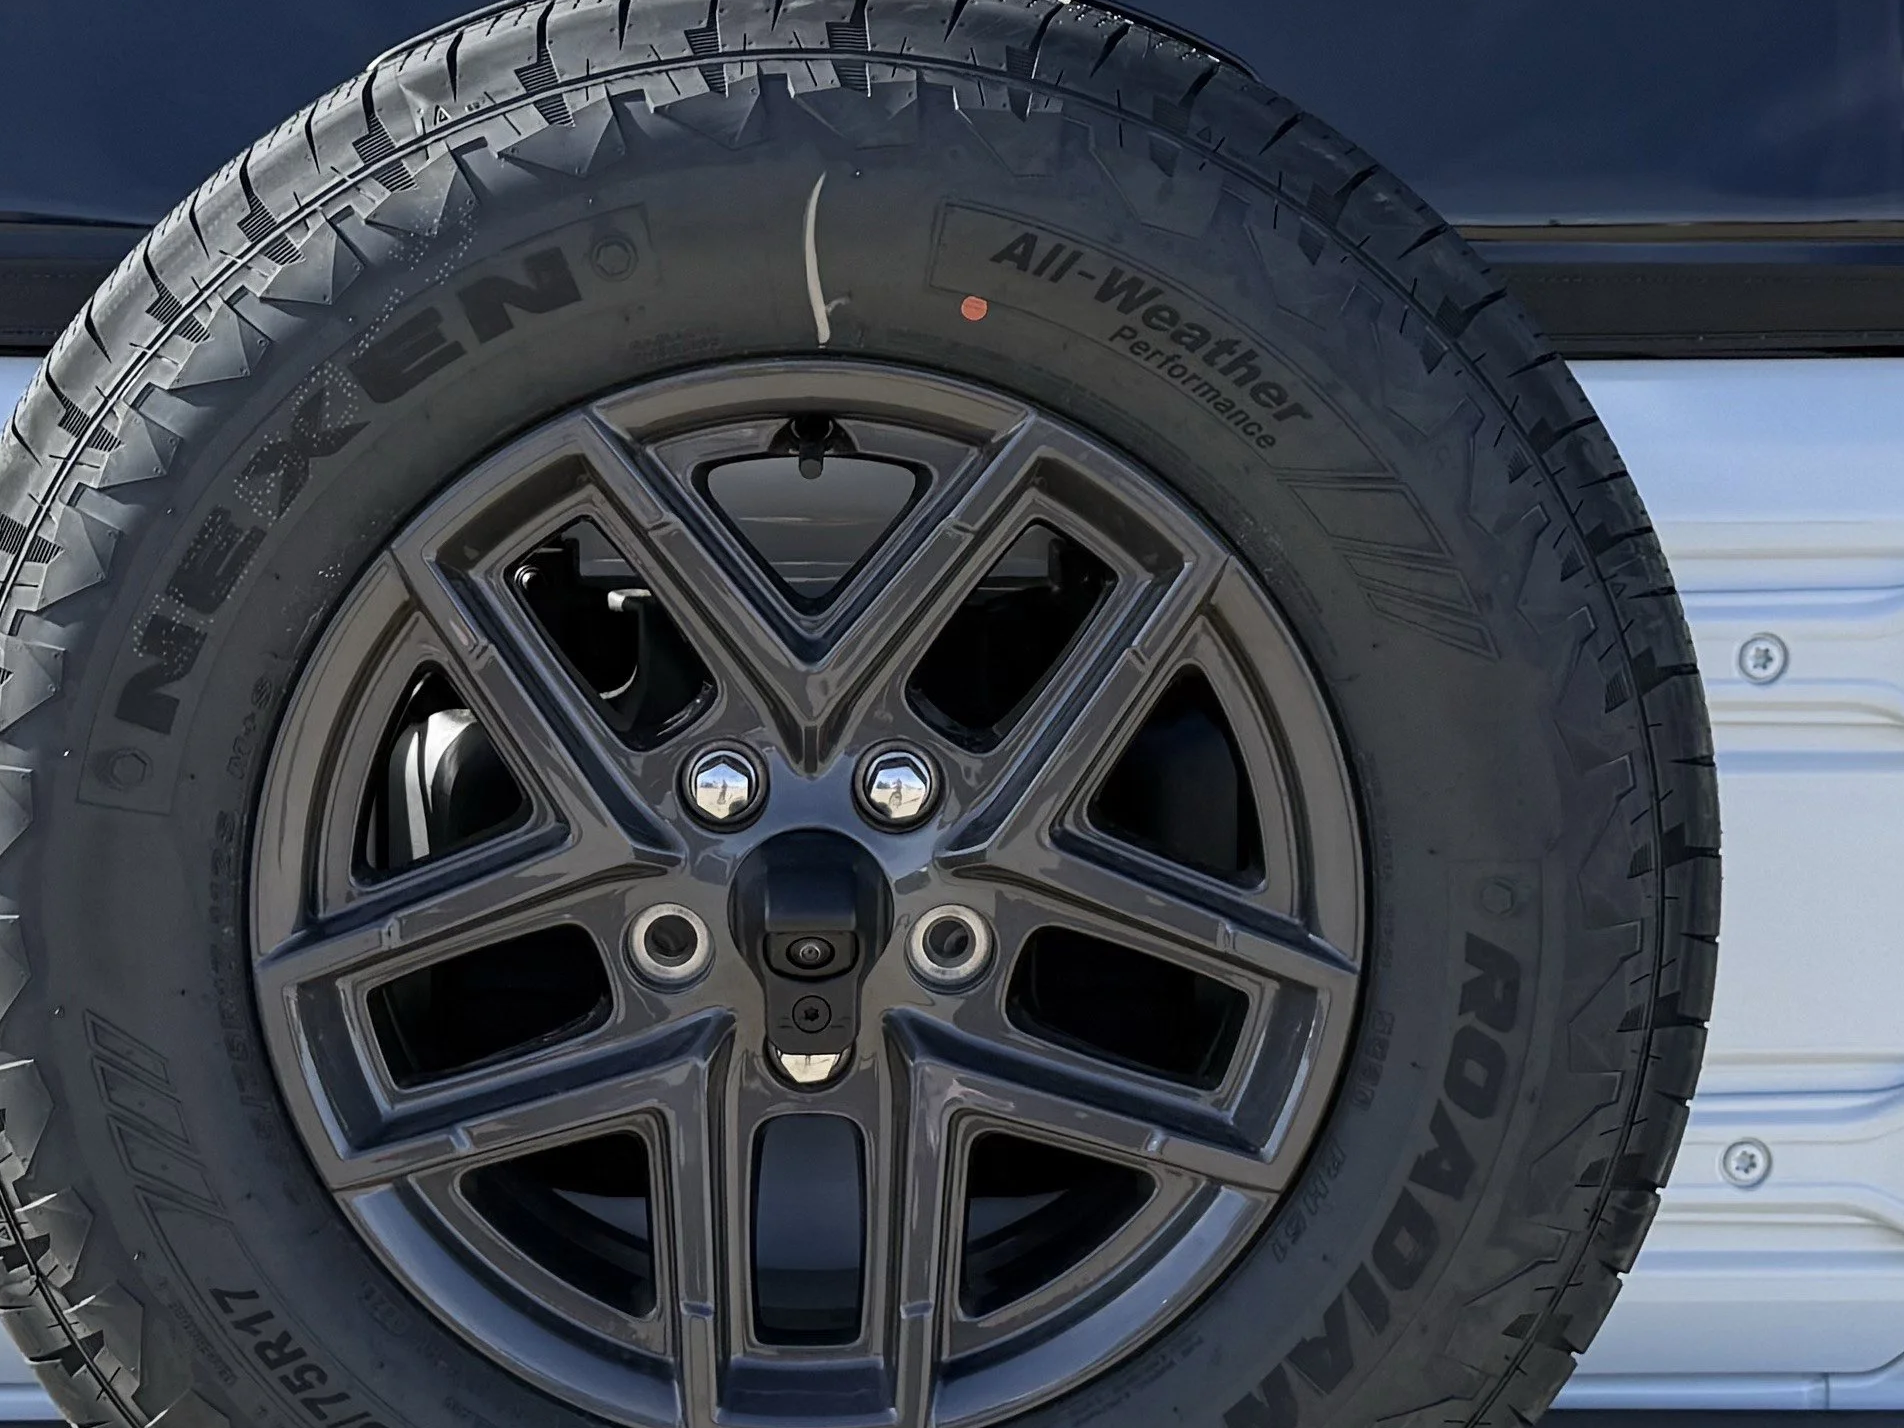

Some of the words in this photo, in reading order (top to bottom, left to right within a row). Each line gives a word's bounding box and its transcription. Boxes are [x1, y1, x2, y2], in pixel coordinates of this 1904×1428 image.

[991, 231, 1312, 422] All-Weather
[1108, 324, 1277, 449] Performance
[117, 249, 580, 734] NEXEN
